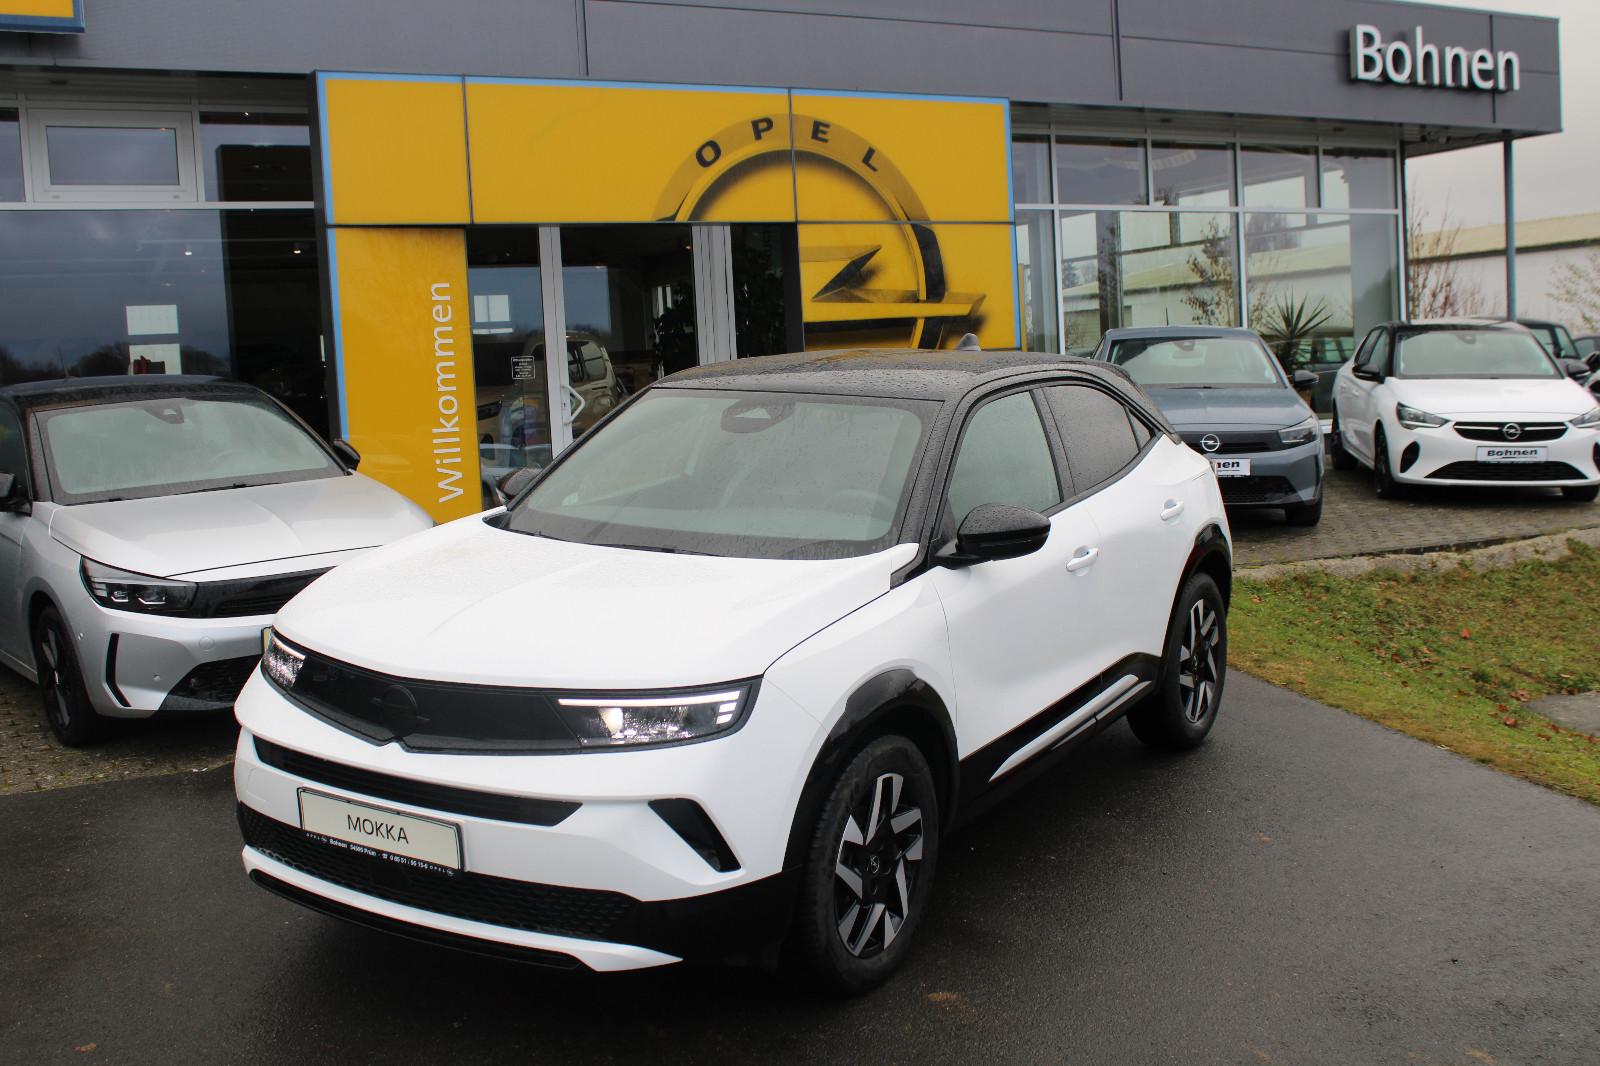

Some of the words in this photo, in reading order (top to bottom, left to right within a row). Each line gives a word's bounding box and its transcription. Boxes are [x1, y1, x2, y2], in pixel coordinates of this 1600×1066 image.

[1355, 23, 1520, 91] Bohnen
[695, 117, 879, 173] OPEL
[431, 282, 464, 503] Willkommen
[1487, 449, 1538, 457] Bohnen
[347, 814, 409, 844] MOKKA
